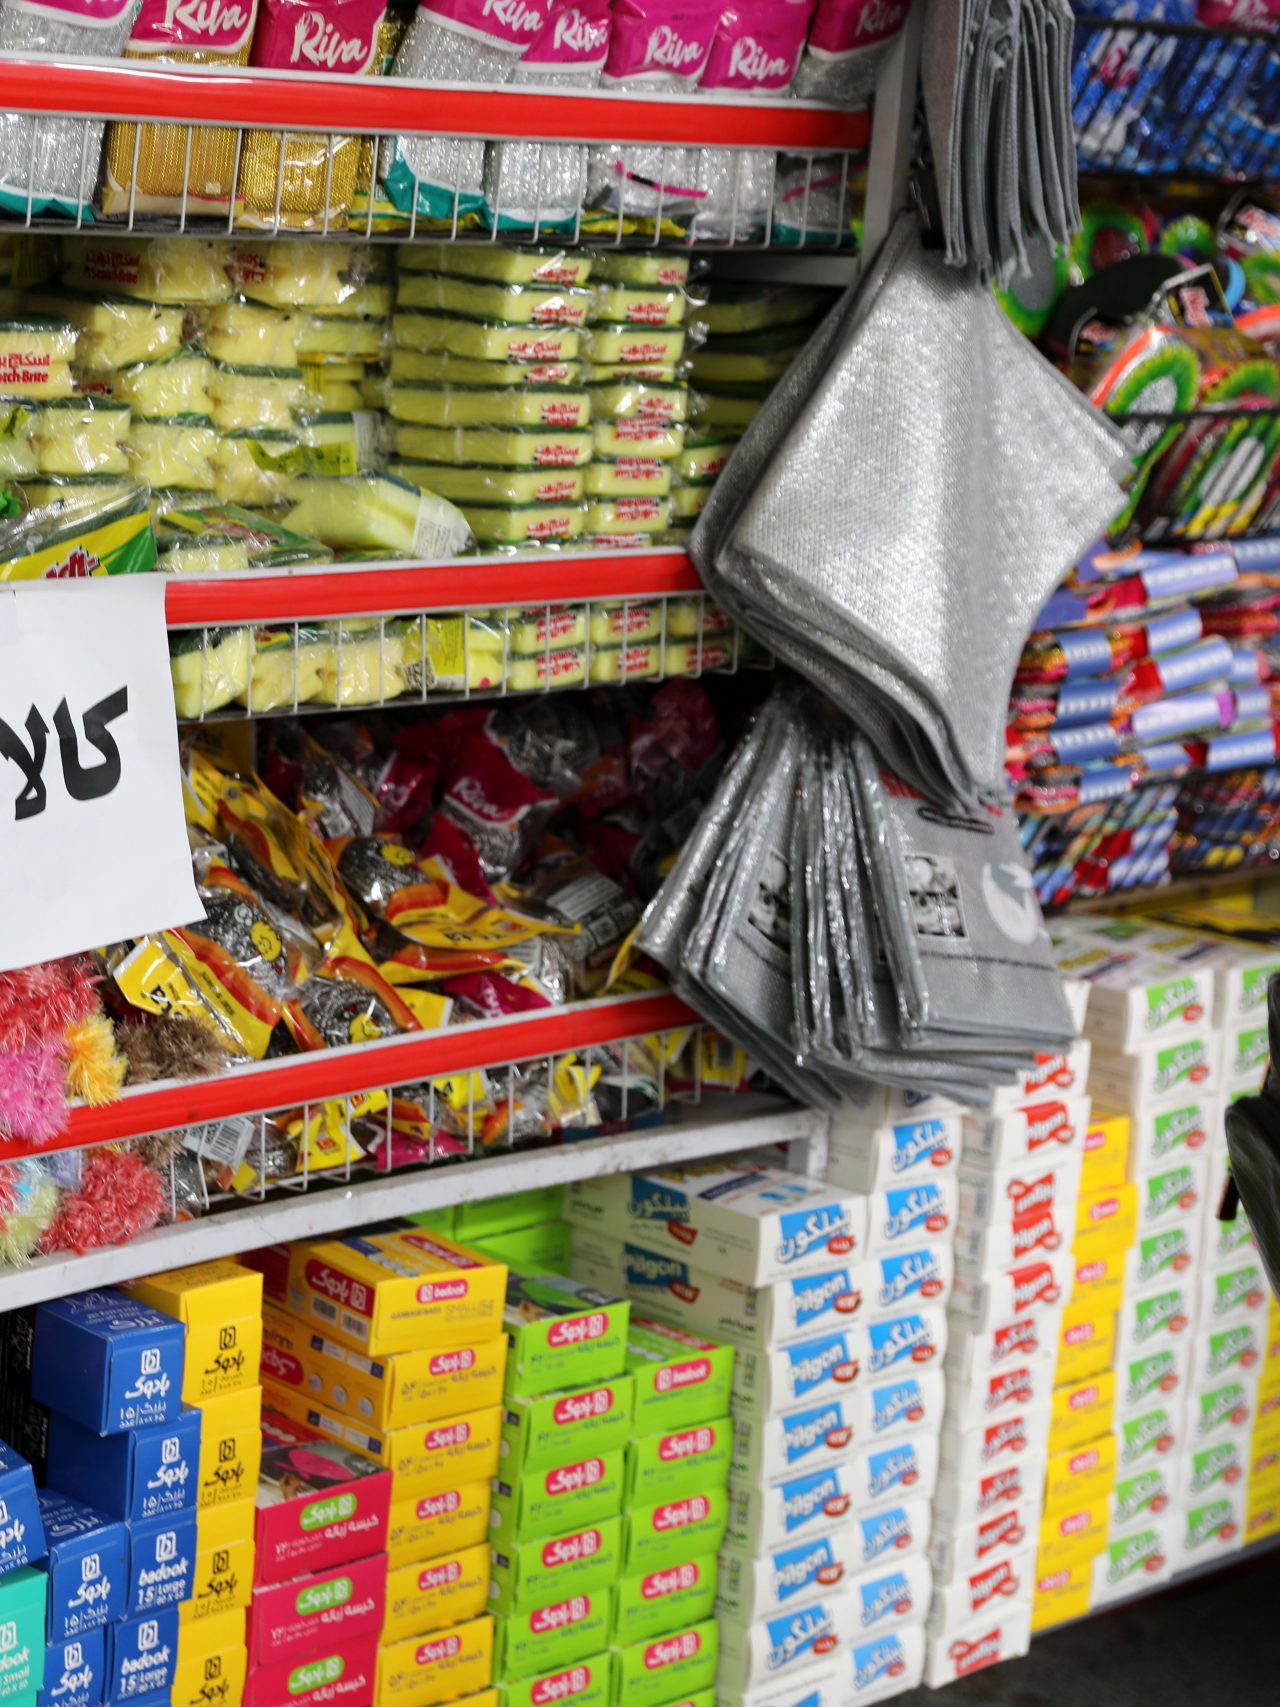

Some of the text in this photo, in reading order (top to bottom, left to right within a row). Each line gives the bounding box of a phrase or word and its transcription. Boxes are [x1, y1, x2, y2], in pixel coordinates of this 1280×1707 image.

[290, 12, 368, 68] Riva
[554, 9, 609, 52] Riva
[646, 25, 704, 68] Riva
[729, 37, 791, 79] Riva
[9, 352, 51, 372] اسکاچ
[1025, 1110, 1067, 1141] Pilgon
[1011, 1217, 1054, 1247] Pilgon
[312, 1268, 350, 1304] بادوک
[791, 1273, 847, 1318] Pilgon
[204, 1349, 245, 1375] بادوک
[789, 1343, 844, 1391] Pilgon
[124, 1373, 170, 1400] بادوک
[780, 1410, 839, 1457] Pilgon
[147, 1461, 189, 1489] بادوک
[204, 1462, 244, 1487] بادوک
[303, 1502, 337, 1525] بادوک
[780, 1476, 836, 1526] Pilgon
[138, 1557, 189, 1588] badook
[198, 1573, 238, 1599] بادوک
[771, 1547, 829, 1597] Pilgon
[68, 1576, 111, 1608] بادوک
[138, 1579, 187, 1606] 15 Large
[299, 1586, 333, 1610] بادوک
[121, 1645, 171, 1676] badook
[3, 1667, 30, 1687] Small
[51, 1664, 93, 1697] بادوک
[120, 1667, 168, 1694] 15 Large
[189, 1678, 230, 1705] بادوک
[290, 1663, 324, 1690] بادوک
